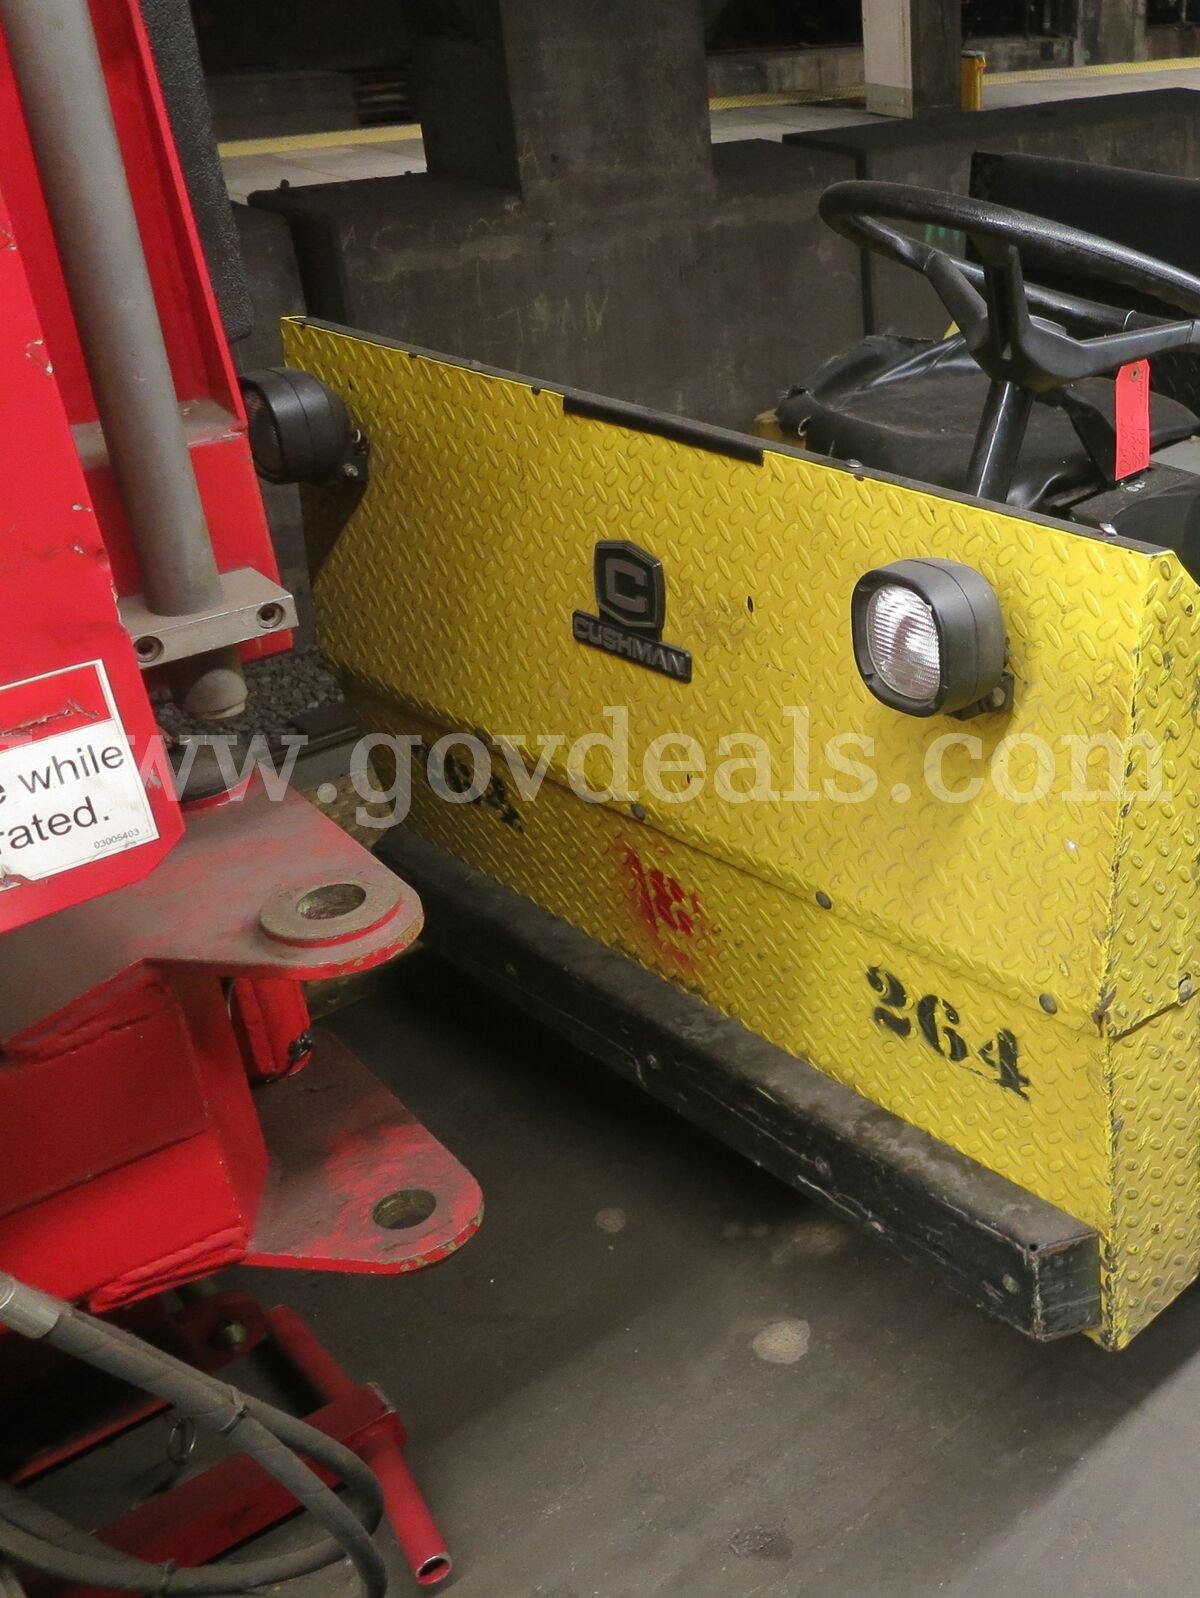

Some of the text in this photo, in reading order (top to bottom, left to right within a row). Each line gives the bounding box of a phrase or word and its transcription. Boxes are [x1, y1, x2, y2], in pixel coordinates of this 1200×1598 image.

[574, 616, 689, 678] CUSHMAN
[18, 744, 124, 794] while
[94, 828, 140, 849] 03005403
[866, 966, 1030, 1101] 264
